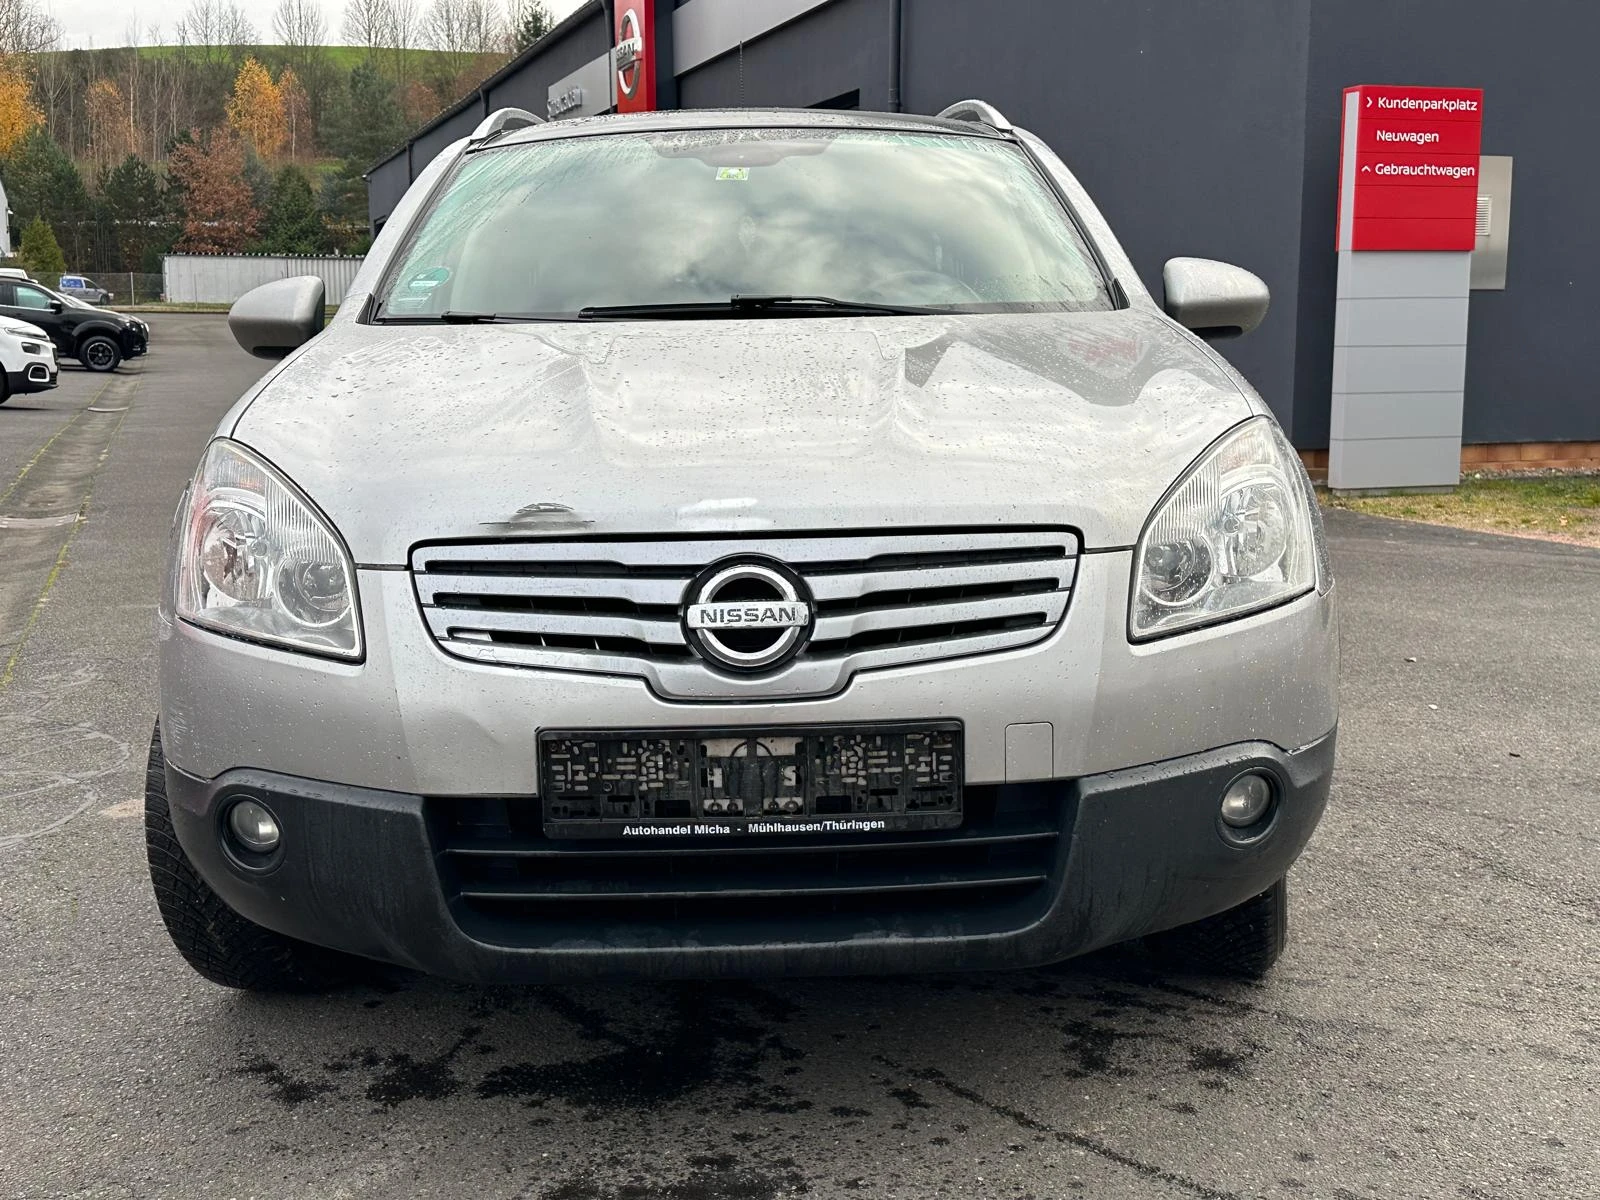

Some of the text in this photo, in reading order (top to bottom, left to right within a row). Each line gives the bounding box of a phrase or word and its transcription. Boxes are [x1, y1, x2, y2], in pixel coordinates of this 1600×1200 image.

[1378, 97, 1478, 112] Kundenparkplatz
[1376, 130, 1440, 145] Neuwagen
[1375, 163, 1475, 178] Gebrauchtwagen
[700, 607, 796, 624] NISSAN
[622, 825, 691, 836] Autohandel
[694, 824, 731, 835] Micha
[748, 820, 885, 833] Mühlhausen/Thüringen
